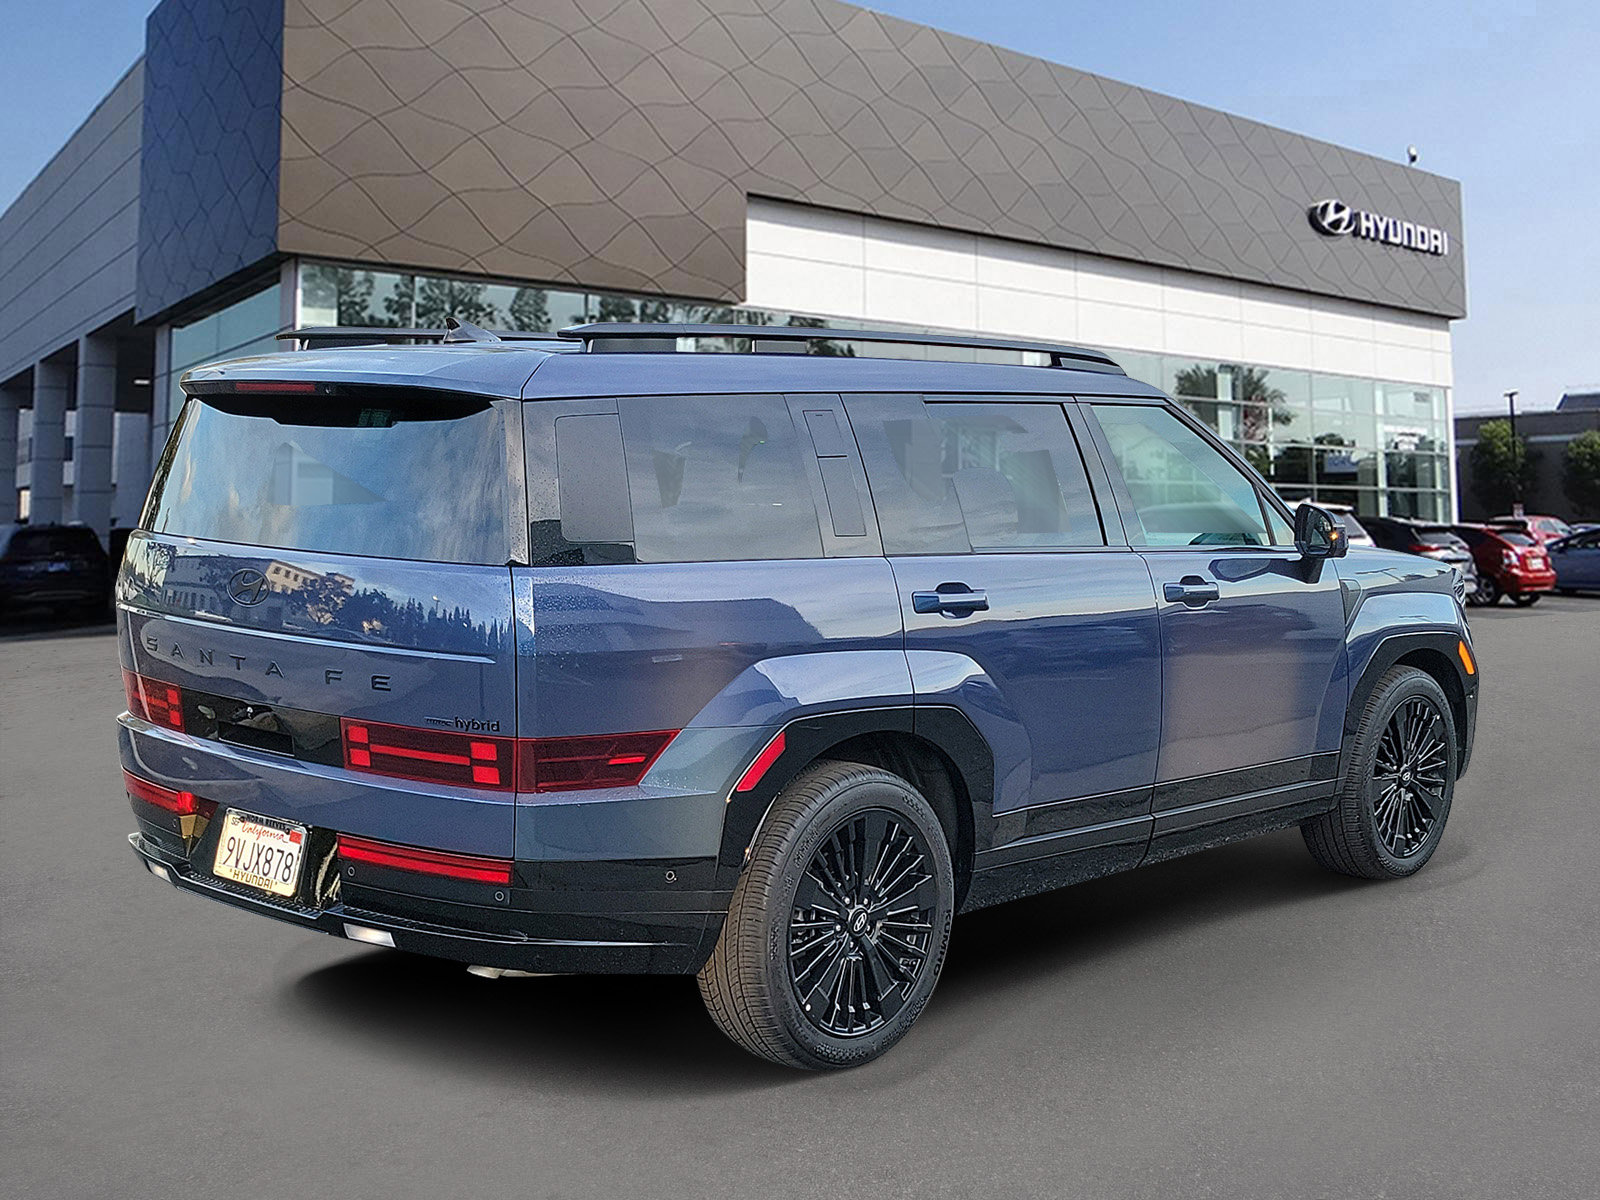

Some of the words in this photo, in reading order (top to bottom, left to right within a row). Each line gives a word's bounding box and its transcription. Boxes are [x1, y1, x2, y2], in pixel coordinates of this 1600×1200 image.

[1360, 211, 1448, 255] HYUNDAI
[146, 637, 285, 679] SANTA
[325, 669, 392, 692] FE
[454, 716, 501, 733] hybrid
[242, 820, 288, 843] California
[223, 836, 294, 882] 9VJX878
[233, 869, 274, 889] HYUNDAI
